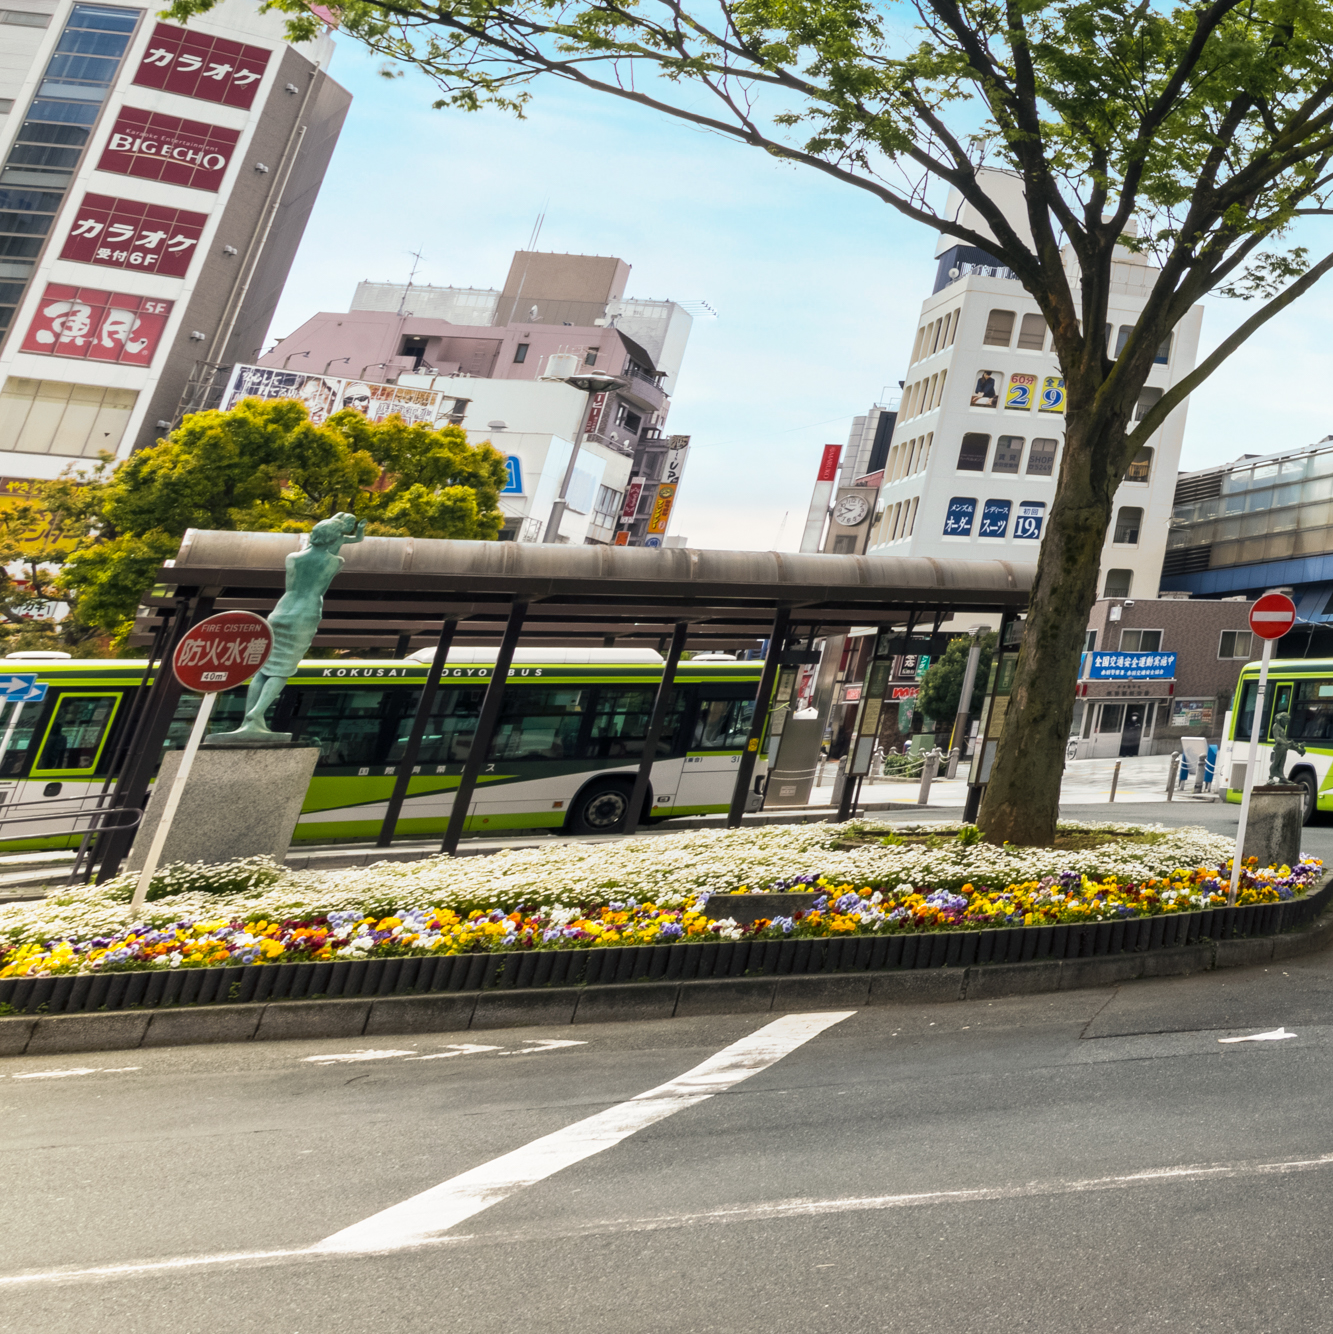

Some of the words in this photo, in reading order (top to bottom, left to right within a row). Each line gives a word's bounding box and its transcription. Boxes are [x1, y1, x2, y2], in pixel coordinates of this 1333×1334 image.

[144, 48, 261, 85] カラオケ
[126, 128, 158, 139] Karaoke
[161, 136, 219, 152] Entertainment
[108, 133, 158, 154] BIG
[161, 144, 226, 171] ECHO
[71, 218, 197, 252] カラオケ
[95, 248, 158, 266] 受付6F
[144, 302, 167, 314] 5F
[35, 298, 148, 354] 魚民
[1011, 375, 1035, 385] 60分
[1007, 385, 1030, 407] 2
[1041, 388, 1063, 409] 9
[1030, 456, 1053, 464] SHOP
[985, 506, 1009, 514] レディース
[1023, 508, 1039, 516] 初回
[945, 516, 971, 532] オーダー
[981, 519, 1006, 534] スーツ
[200, 624, 222, 633] FIRE
[223, 623, 262, 633] CISTERN
[177, 637, 269, 666] 防火水槽
[322, 668, 407, 677] KOKUSAI
[427, 668, 488, 677] OGYO
[507, 668, 543, 677] BUS
